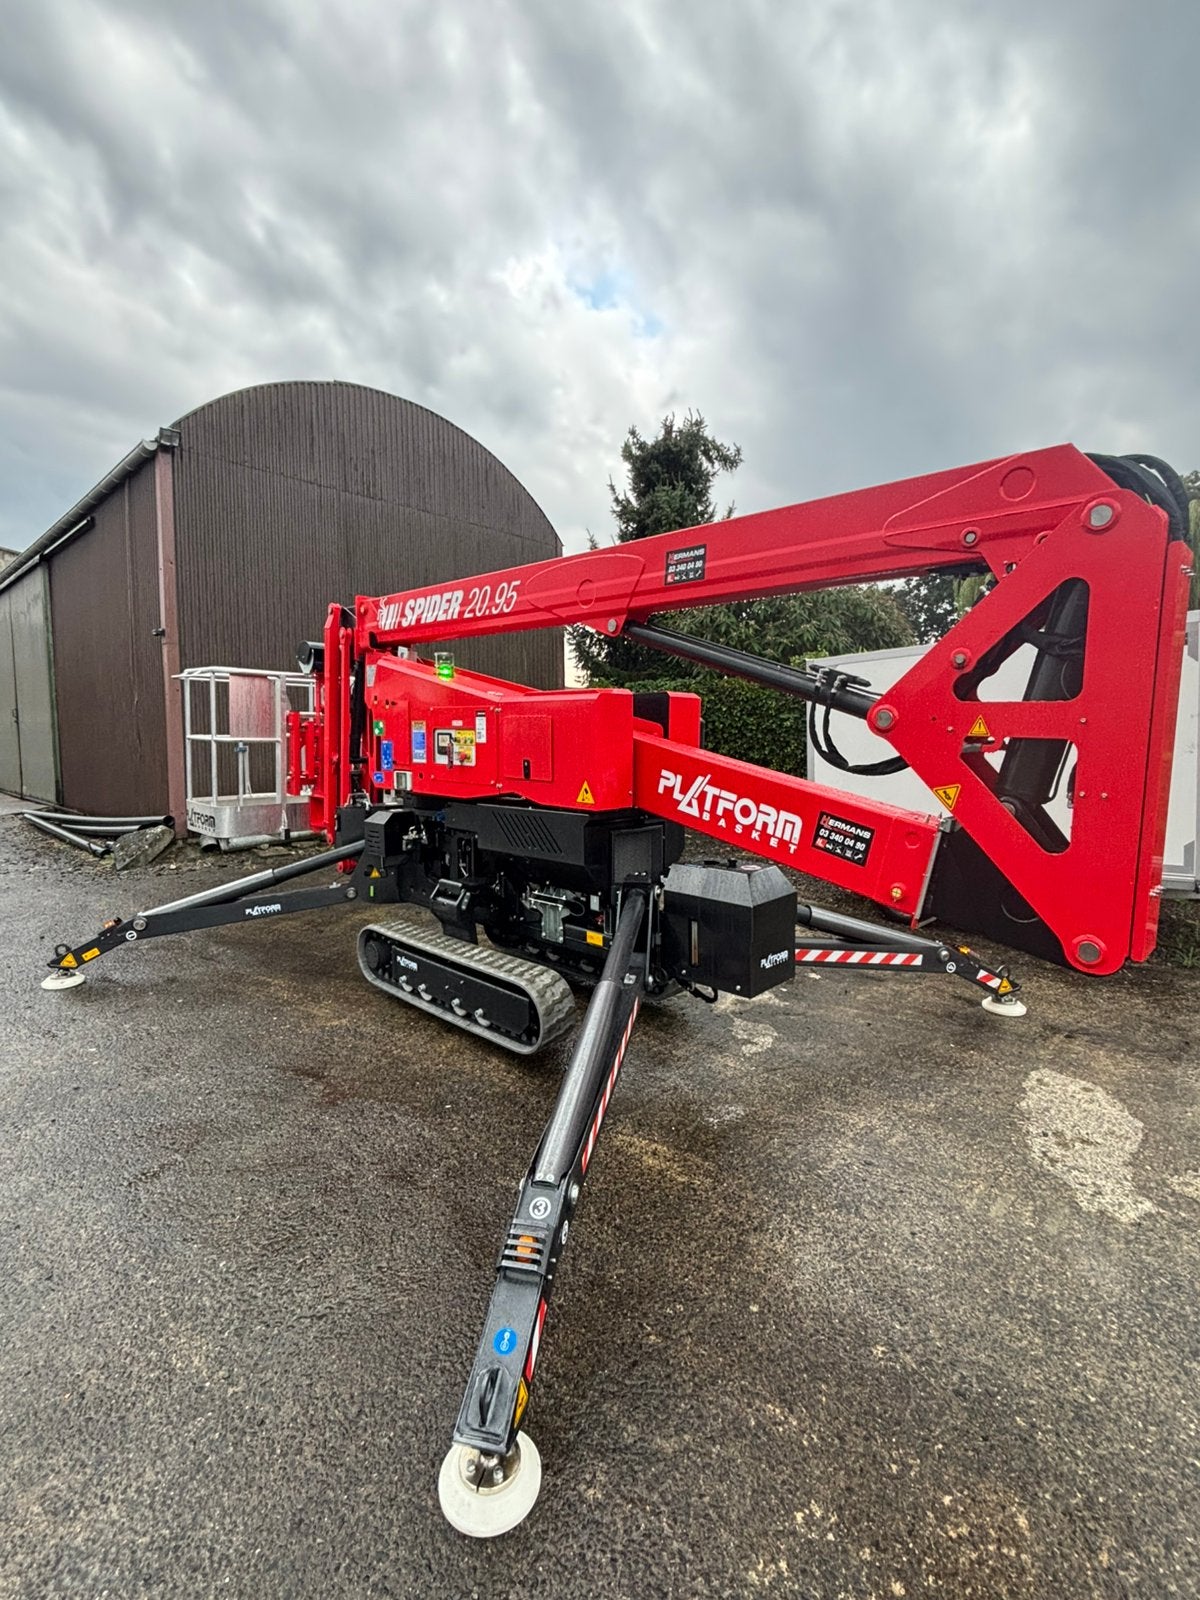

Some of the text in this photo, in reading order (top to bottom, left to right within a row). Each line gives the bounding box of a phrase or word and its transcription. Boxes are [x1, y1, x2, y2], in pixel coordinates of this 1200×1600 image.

[402, 580, 521, 627] SPIDER 20.95
[658, 769, 803, 843] PLATFORM
[702, 811, 798, 854] BASKET
[819, 829, 829, 838] 03
[829, 832, 844, 843] 340
[844, 838, 855, 847] 04
[855, 842, 866, 851] 90
[820, 815, 871, 839] HERMANS
[532, 1199, 548, 1216] 3
